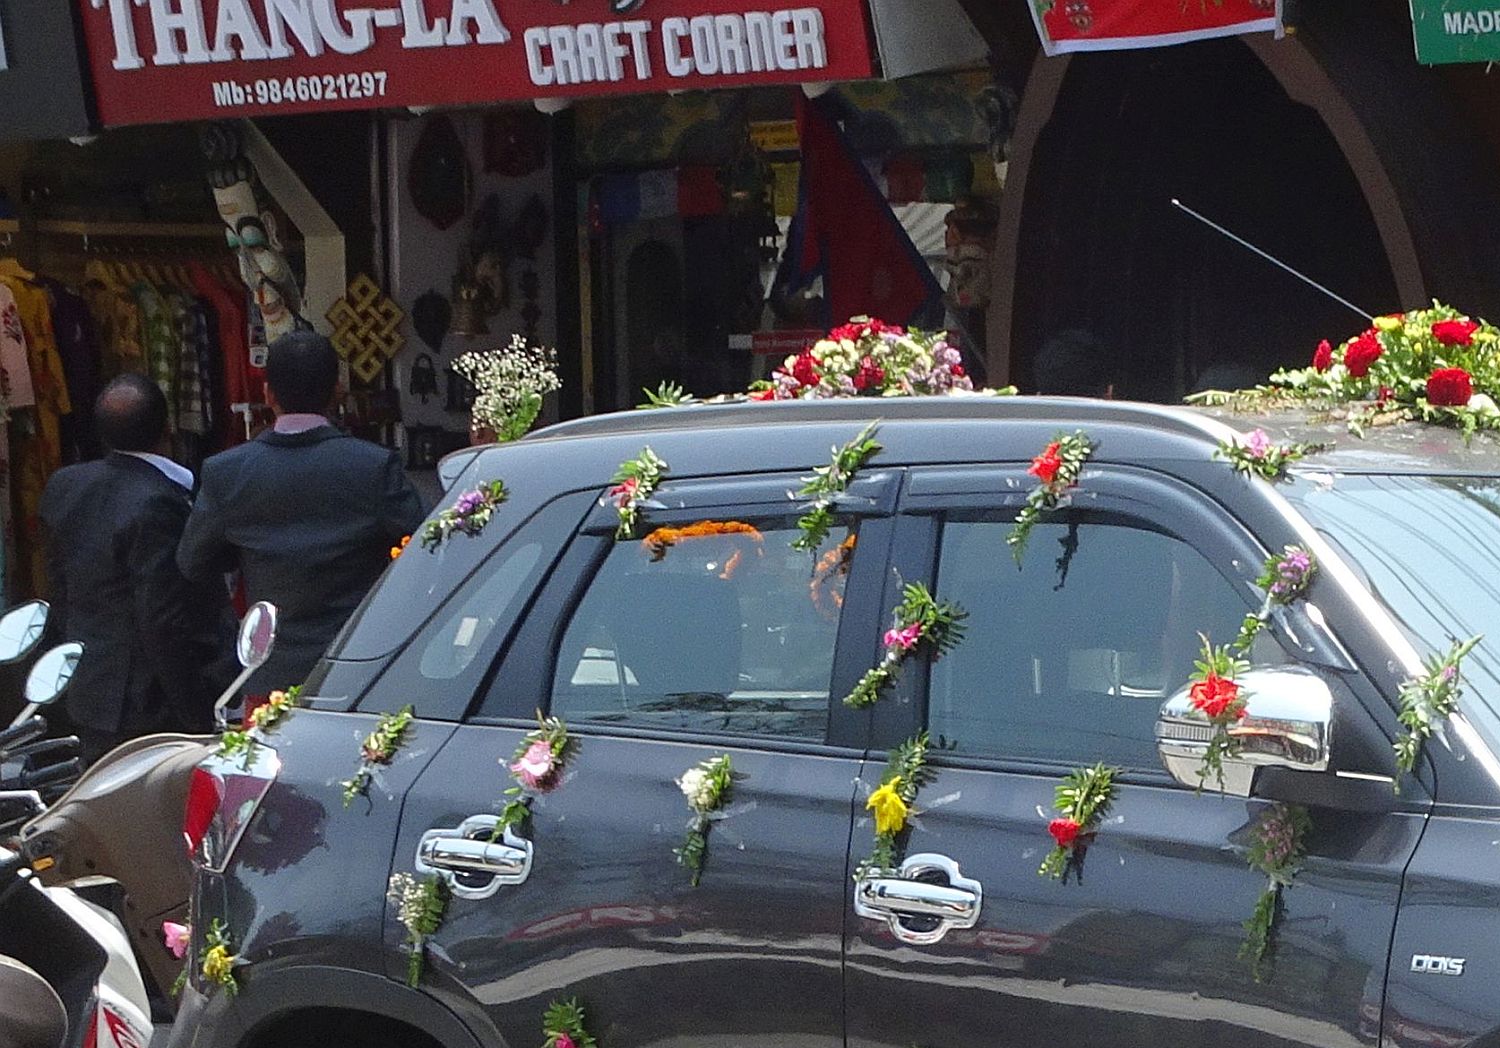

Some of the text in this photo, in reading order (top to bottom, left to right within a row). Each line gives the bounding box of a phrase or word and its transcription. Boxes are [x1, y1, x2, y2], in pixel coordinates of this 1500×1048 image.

[91, 0, 510, 70] THANG-LA
[524, 7, 828, 86] CRAFT CORNER
[212, 71, 388, 107] Mb:9846021297
